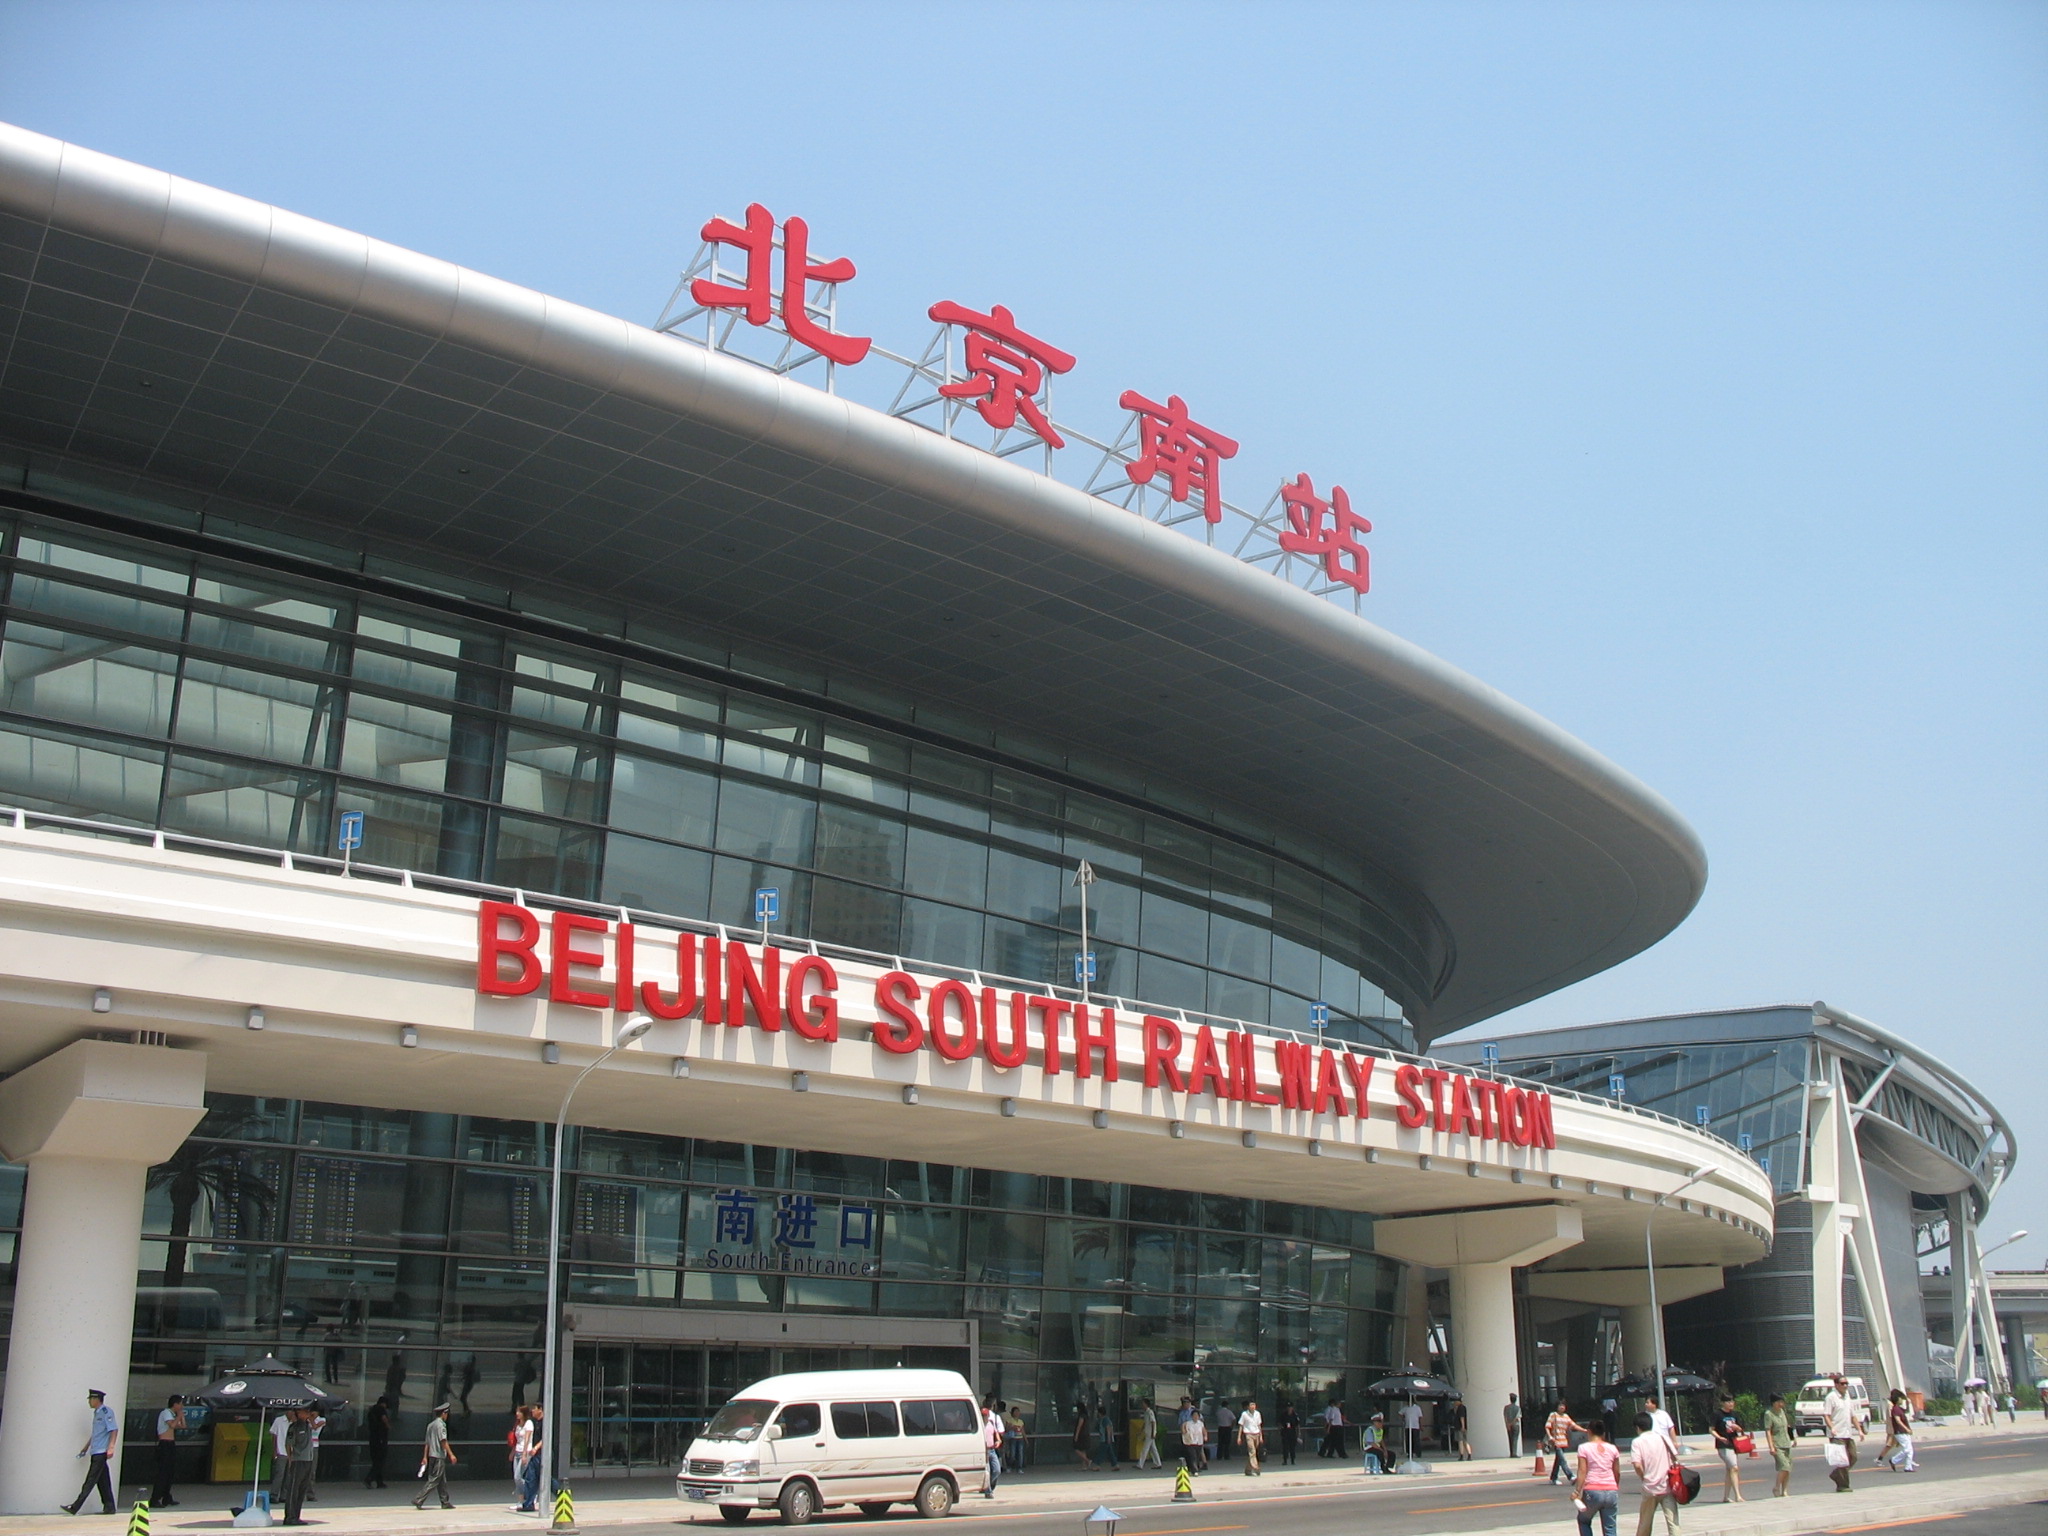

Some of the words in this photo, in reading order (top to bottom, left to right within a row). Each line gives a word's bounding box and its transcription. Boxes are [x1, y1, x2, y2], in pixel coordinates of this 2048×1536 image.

[692, 203, 1371, 594] 北京南站
[478, 900, 839, 1043] BEIJING
[873, 971, 1119, 1082] SOUTH
[1144, 1015, 1375, 1119] RAILWAY
[1395, 1064, 1556, 1150] STATION
[713, 1188, 873, 1250] 南进口
[706, 1248, 770, 1271] South
[780, 1252, 872, 1277] Entrance
[269, 1398, 304, 1406] POLICE
